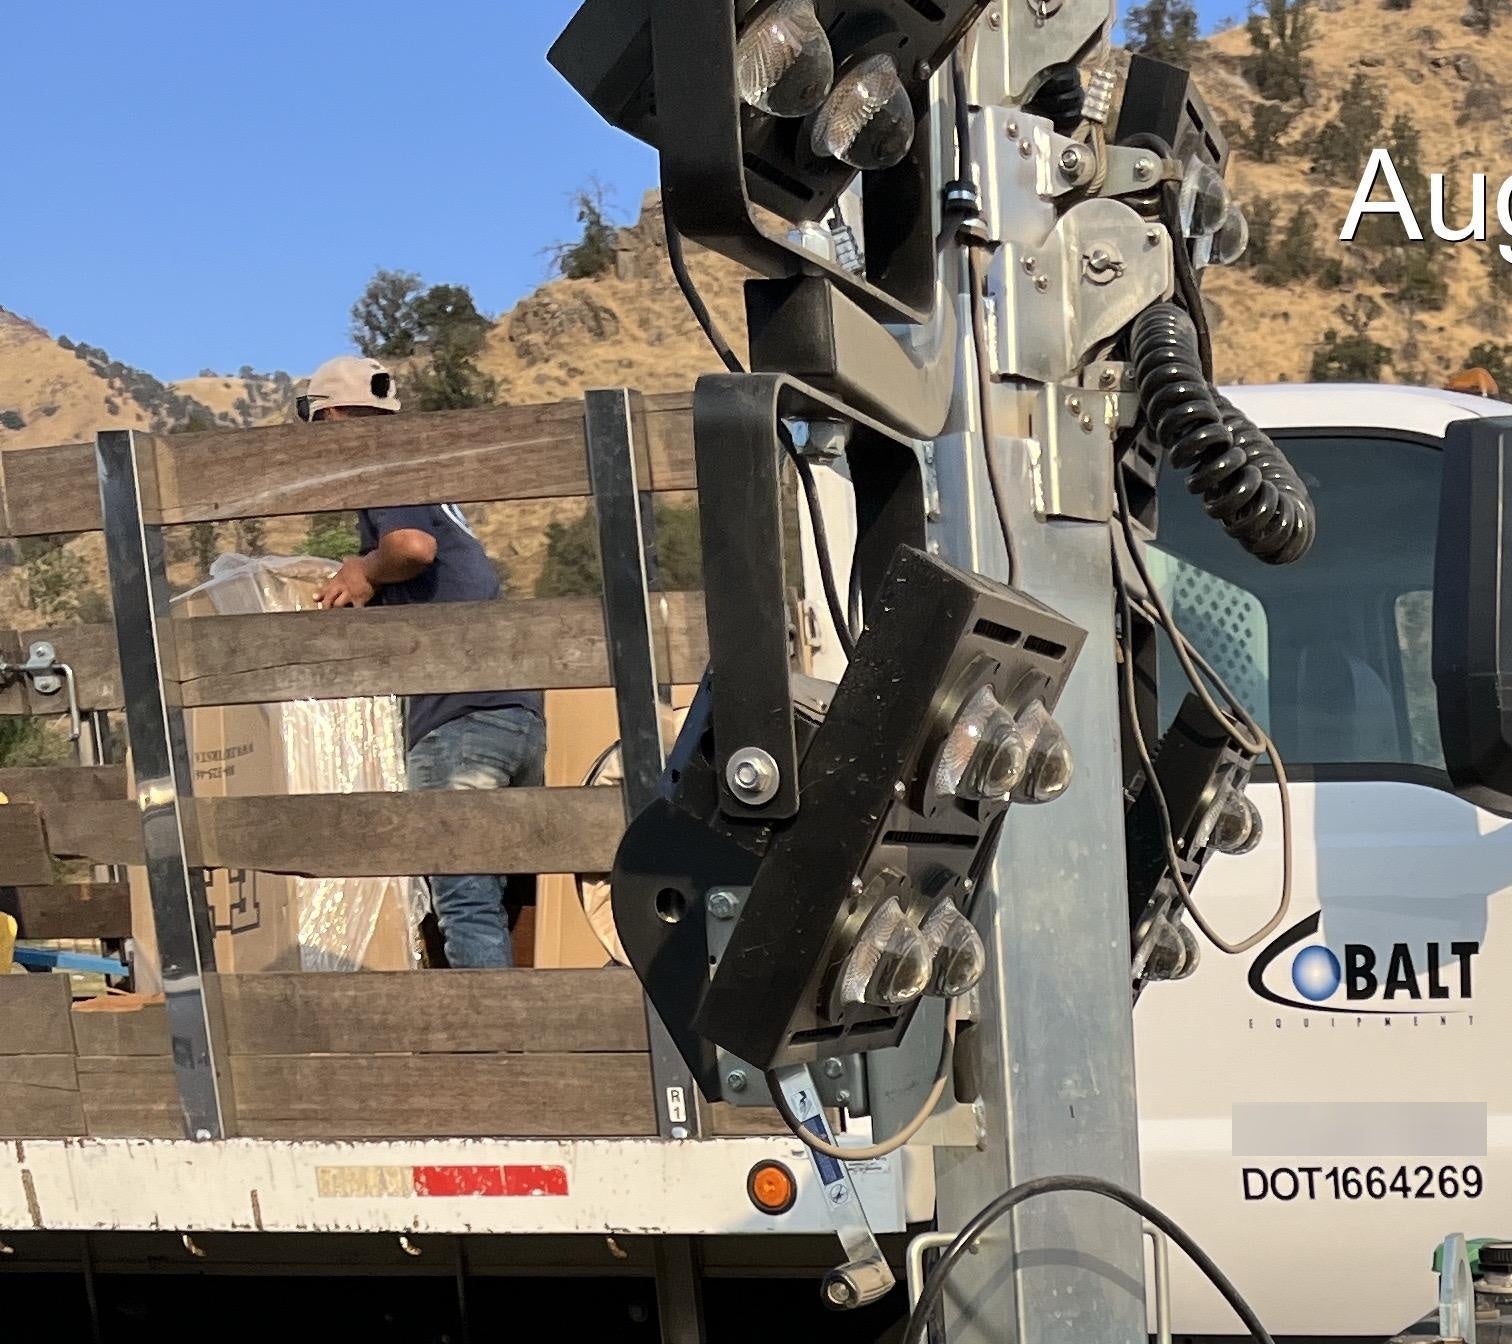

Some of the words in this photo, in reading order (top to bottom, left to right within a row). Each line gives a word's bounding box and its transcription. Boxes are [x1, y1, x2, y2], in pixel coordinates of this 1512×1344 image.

[1248, 1014, 1475, 1029] EQUIPMENT
[671, 1089, 681, 1103] R
[673, 1106, 681, 1120] 1
[1242, 1165, 1484, 1201] DOT1664269
